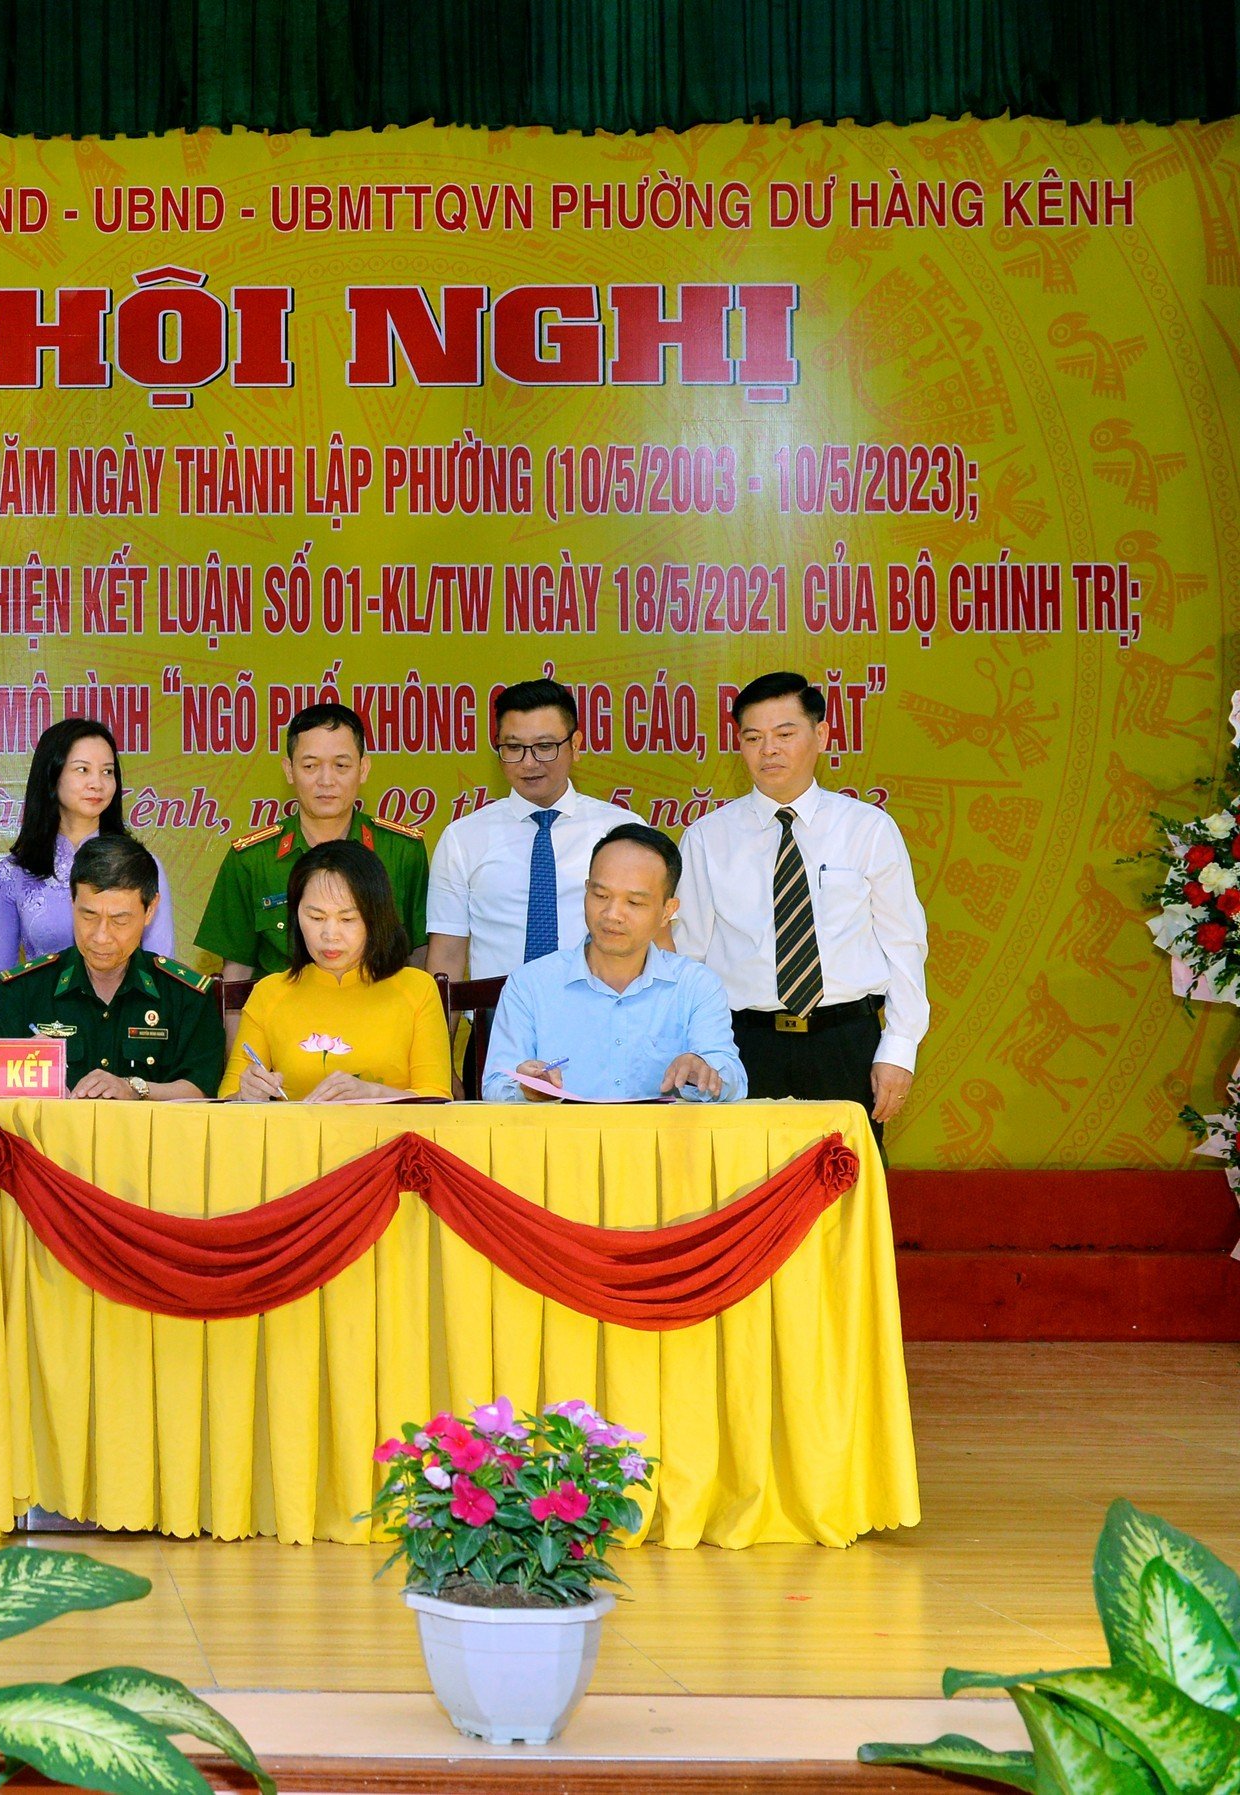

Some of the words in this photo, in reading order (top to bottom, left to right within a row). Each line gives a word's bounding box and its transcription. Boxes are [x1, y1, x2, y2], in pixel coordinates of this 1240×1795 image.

[94, 185, 225, 233] UBND
[271, 182, 533, 234] UBMTTQVN
[550, 169, 752, 231] PHƯỜNG
[769, 173, 839, 230] DƯ
[850, 170, 984, 229] HÀNG
[1002, 168, 1135, 228] KÊNH
[345, 282, 801, 404] NGHỊ
[67, 438, 165, 517] NGÀY
[175, 438, 294, 517] THÀNH
[305, 437, 373, 534] LẬP
[383, 433, 532, 516] PHƯỜNG
[545, 443, 737, 521] (10/5/2003
[773, 443, 978, 523] 10/5/2023);
[82, 542, 150, 635] KẾT
[158, 549, 253, 650] LUẬN
[263, 540, 312, 635] SỐ
[322, 563, 495, 635] 01-KL/TW
[504, 549, 602, 634] NGÀY
[613, 563, 788, 634] 18/5/2021
[803, 539, 877, 634] CỦA
[888, 549, 938, 648] BỘ
[948, 548, 1062, 633] CHÍNH
[1071, 561, 1142, 647] TRỊ;
[624, 669, 706, 761] CÁO,
[122, 787, 232, 835] ênh,
[378, 787, 437, 828] 09
[6, 1050, 53, 1088] KẾT
